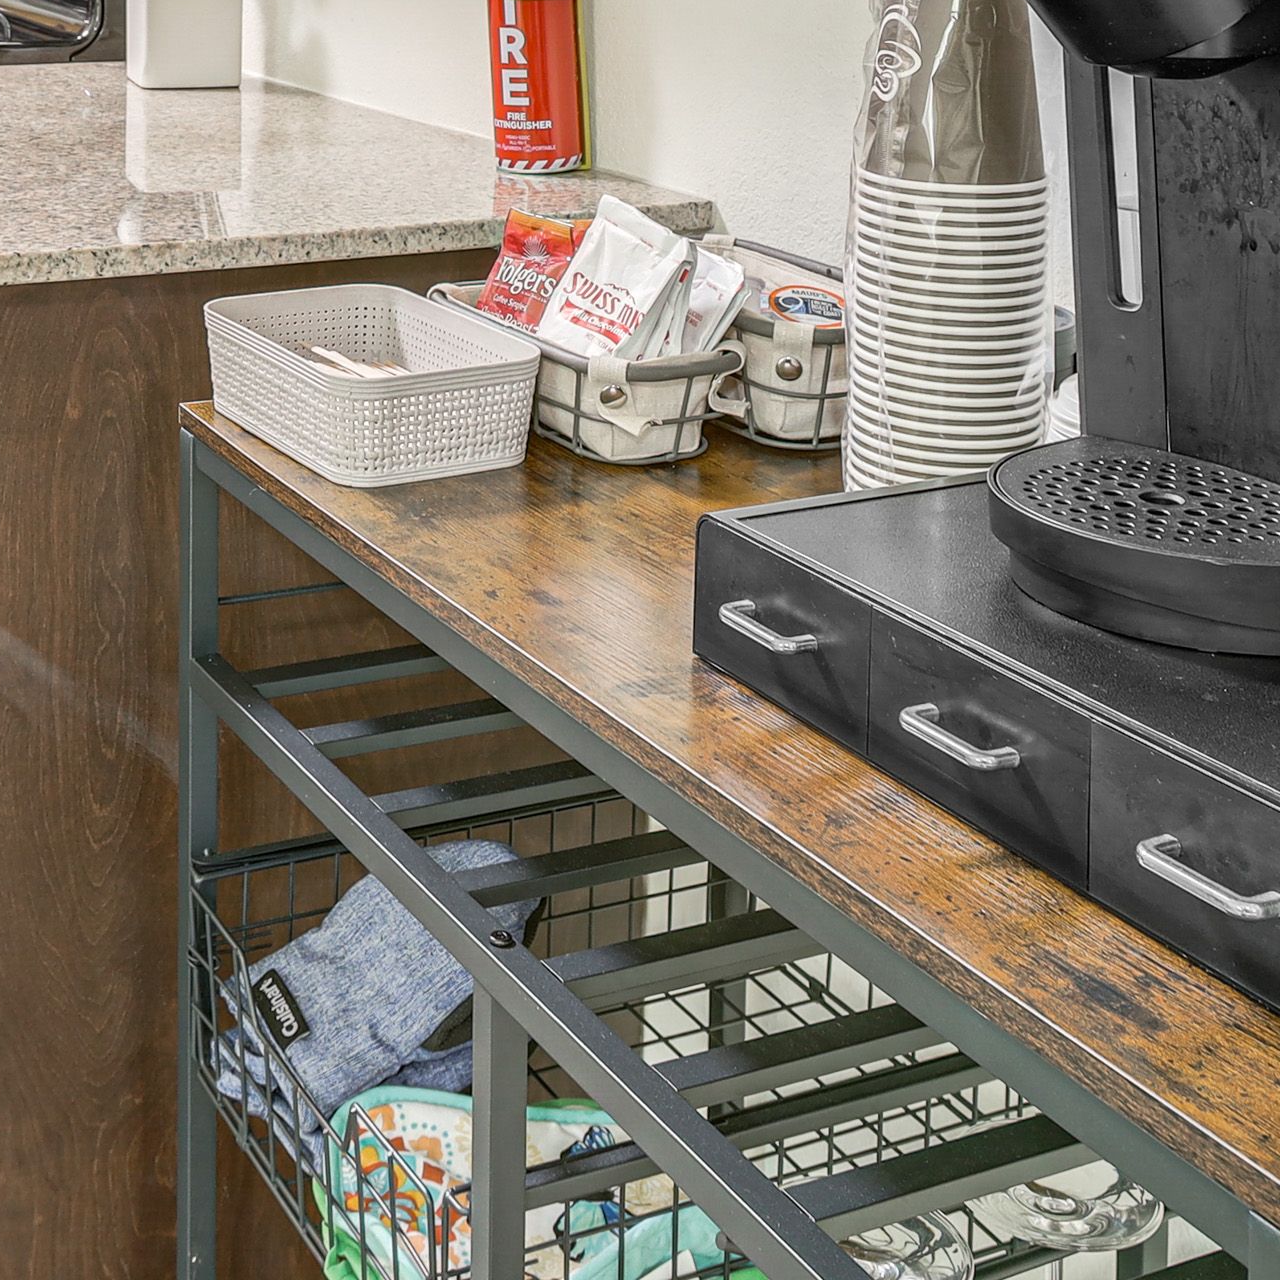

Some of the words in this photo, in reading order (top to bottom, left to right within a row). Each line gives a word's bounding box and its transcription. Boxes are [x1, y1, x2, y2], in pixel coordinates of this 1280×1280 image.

[494, 119, 552, 130] XTINGUISHER
[506, 112, 527, 121] FIRE
[494, 255, 557, 298] Folgers
[563, 271, 621, 315] SWISS
[259, 977, 299, 1037] Cuisinart
